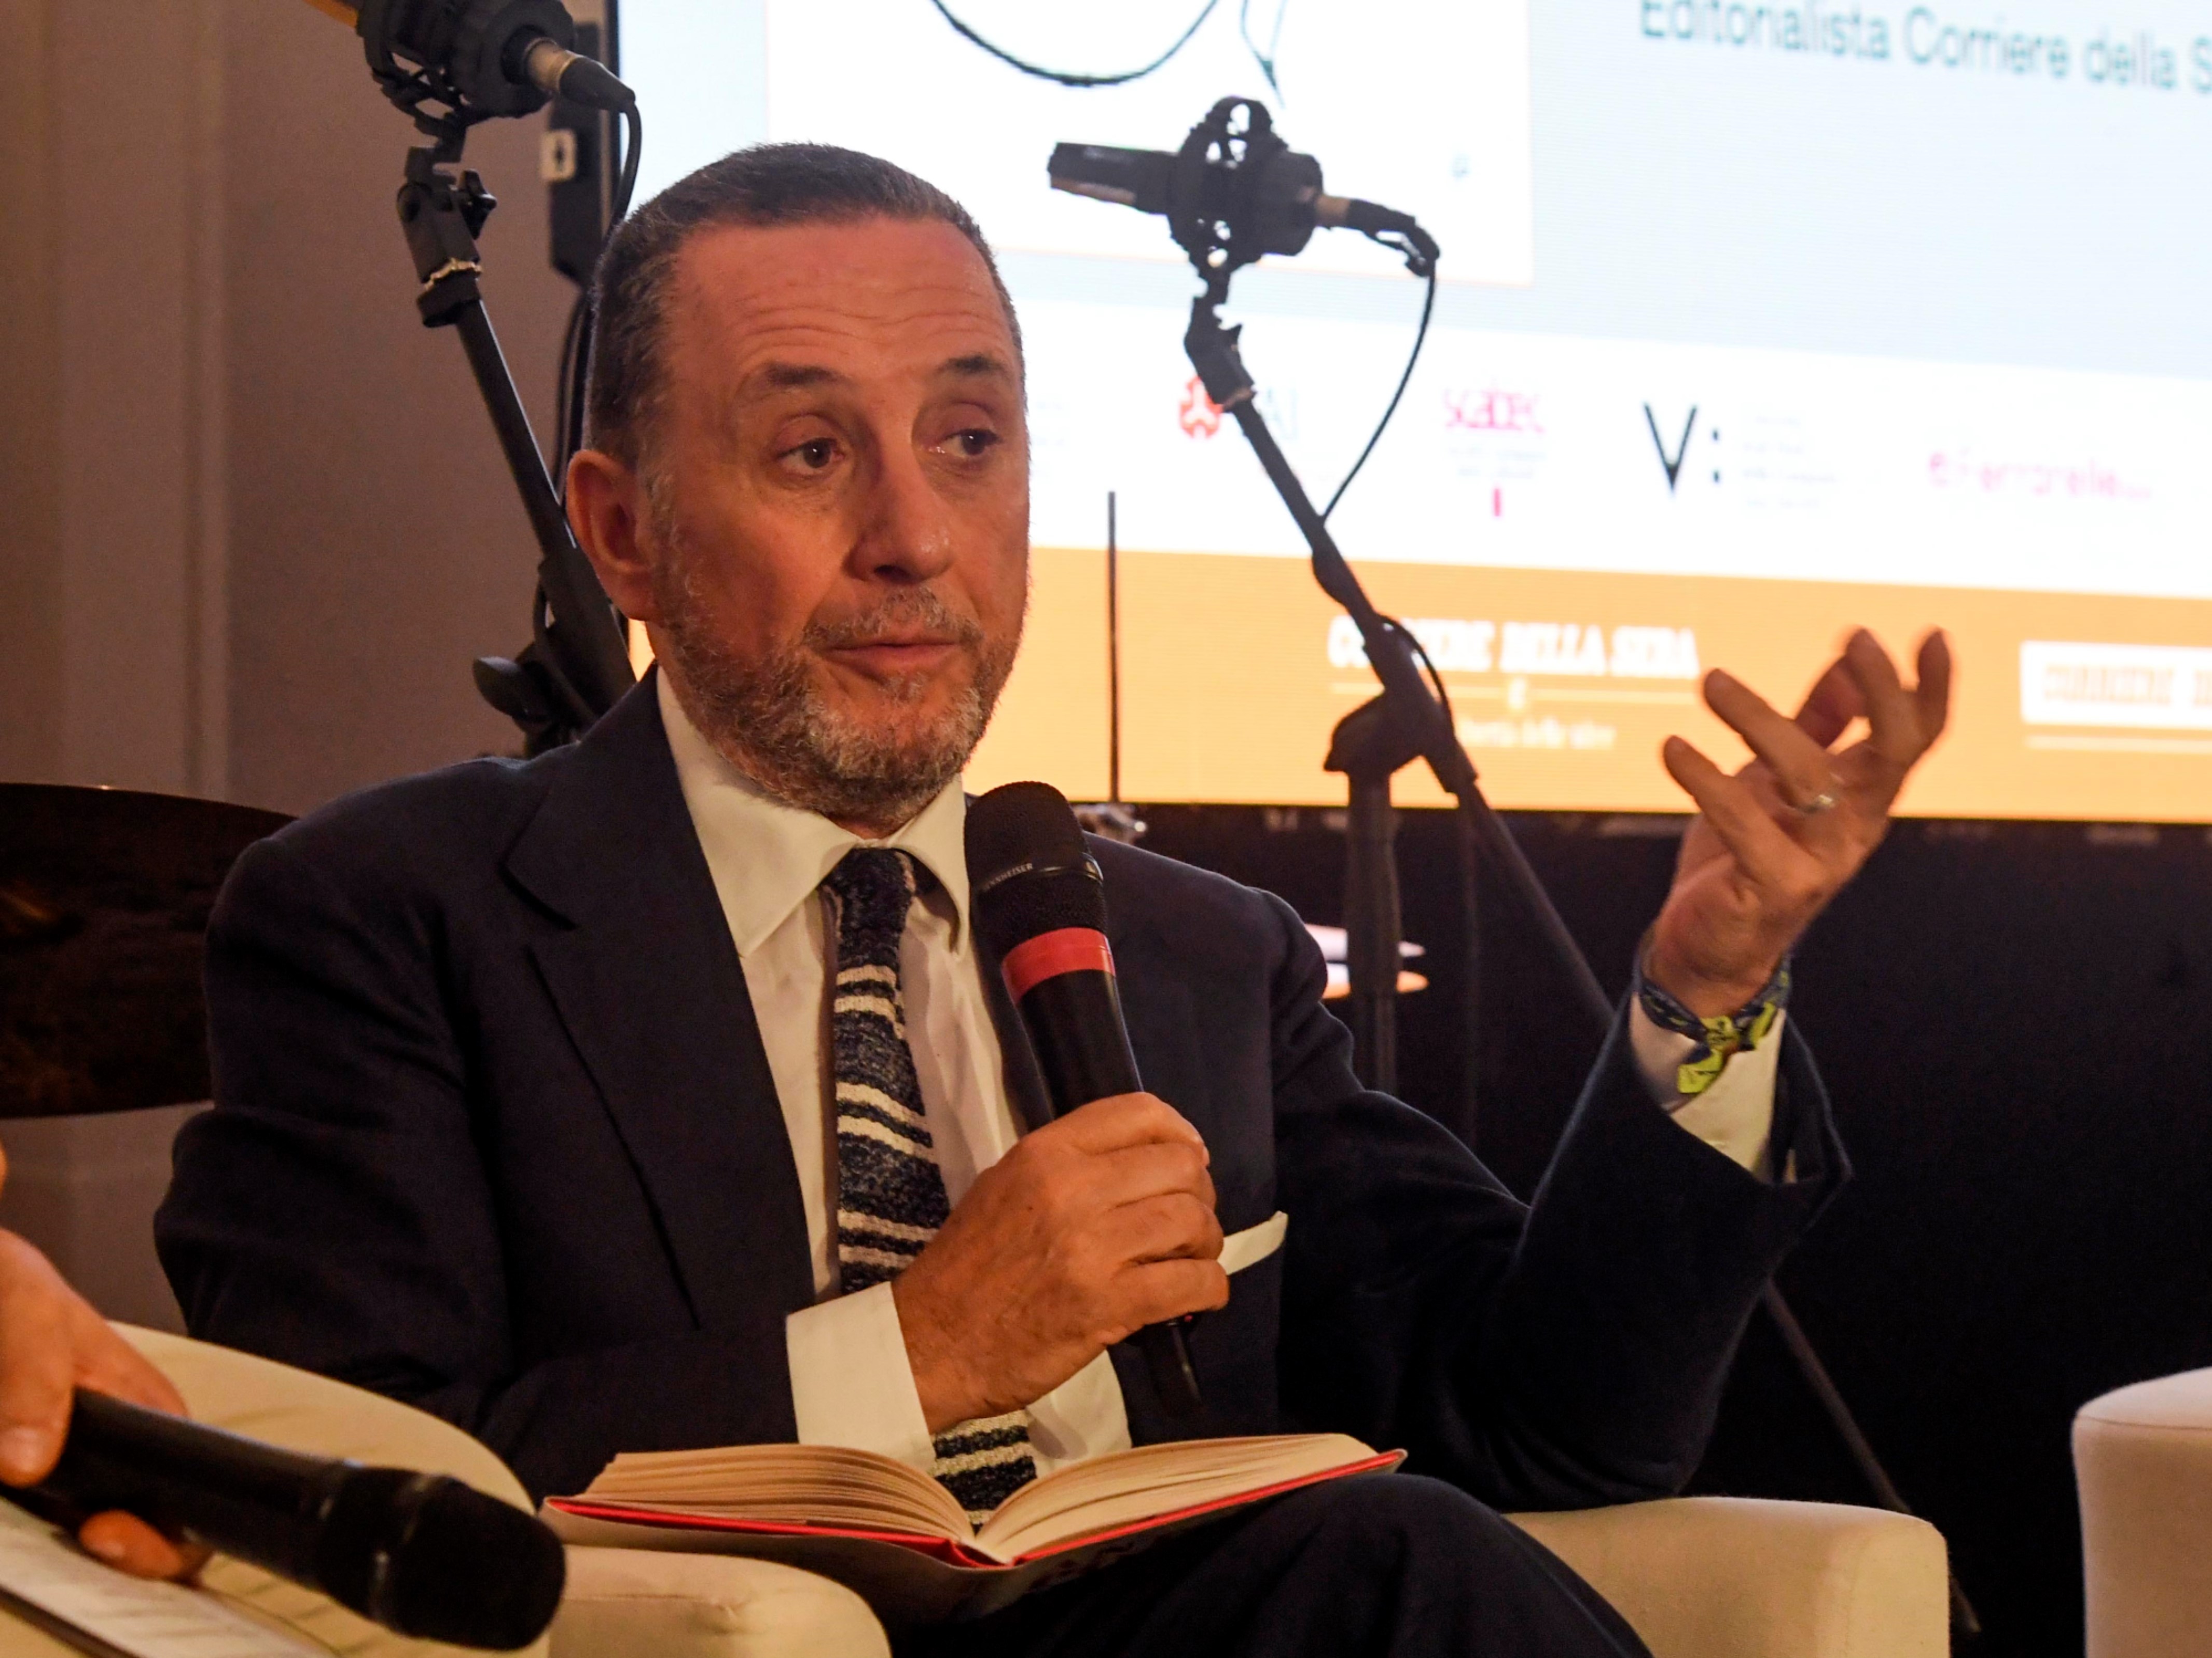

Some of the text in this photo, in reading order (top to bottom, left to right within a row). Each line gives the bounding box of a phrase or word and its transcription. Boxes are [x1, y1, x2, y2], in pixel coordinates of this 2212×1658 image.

[1640, 0, 1892, 58] Editorialista
[1901, 5, 2071, 79] Corriere
[2084, 24, 2178, 90] della
[1500, 621, 1607, 676] DELLA
[1609, 625, 1700, 681] SERA
